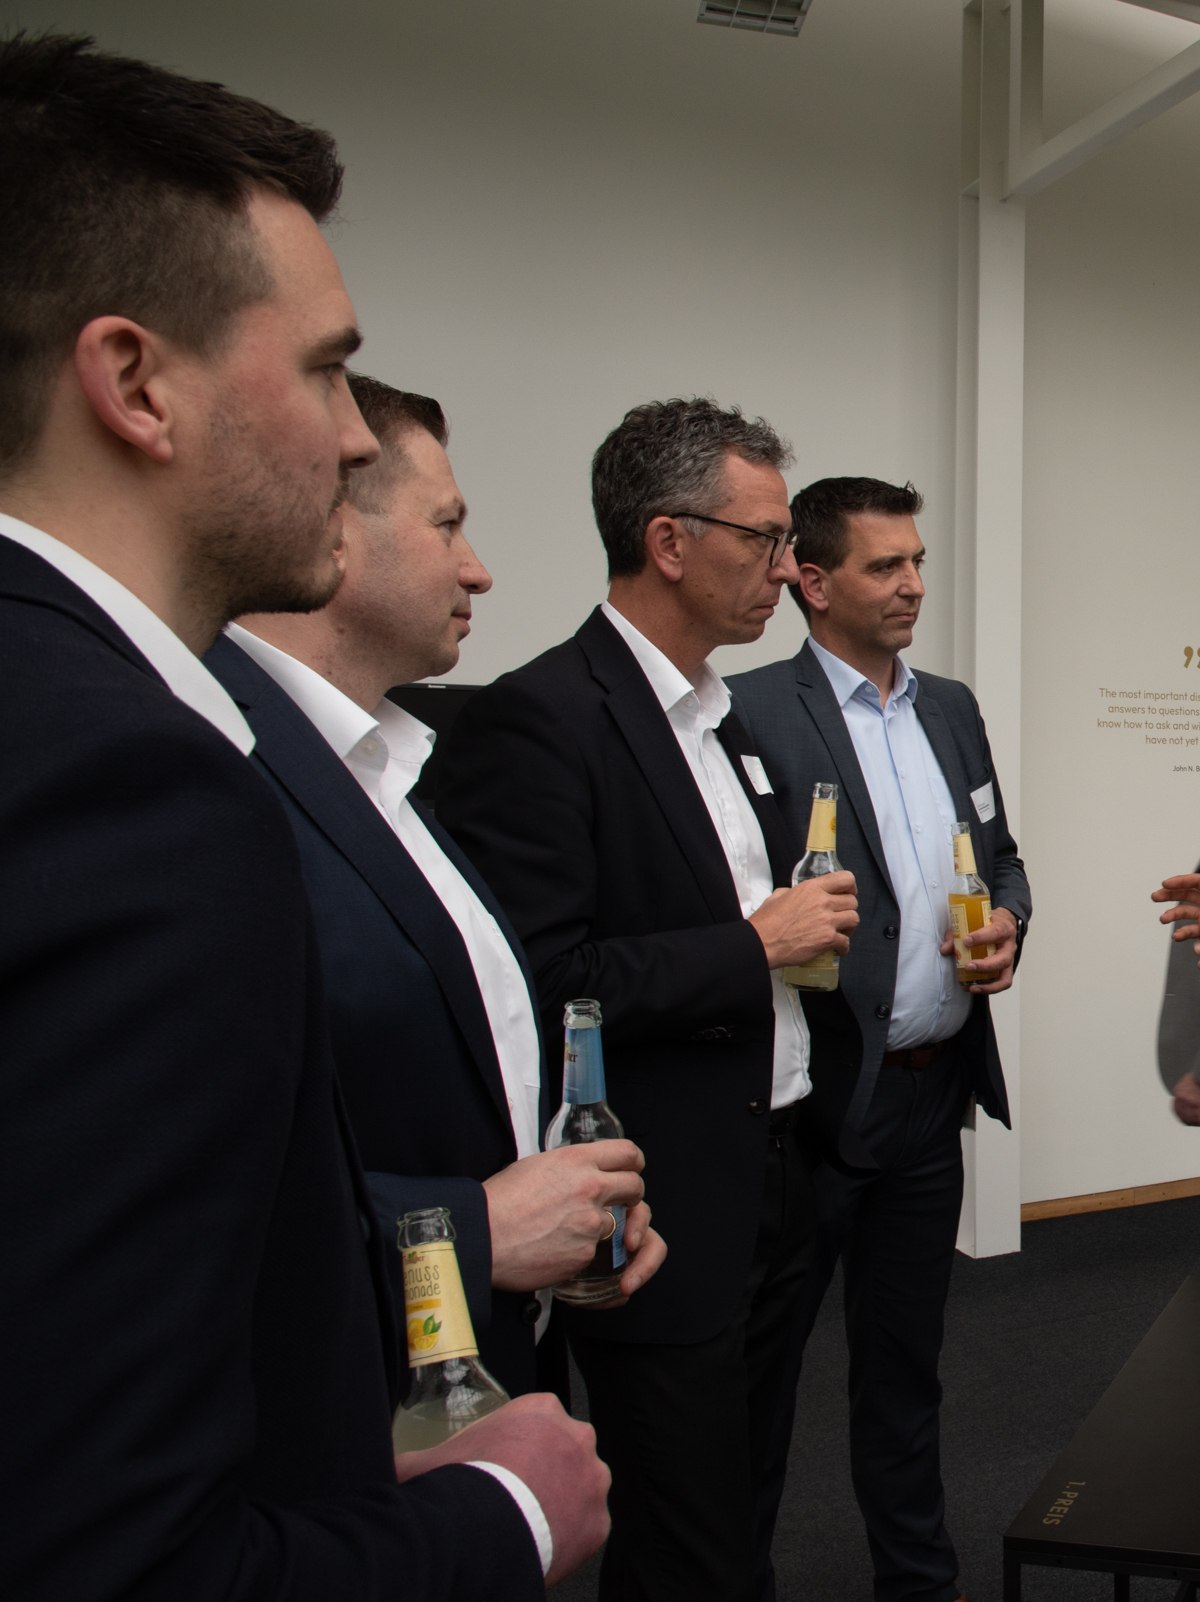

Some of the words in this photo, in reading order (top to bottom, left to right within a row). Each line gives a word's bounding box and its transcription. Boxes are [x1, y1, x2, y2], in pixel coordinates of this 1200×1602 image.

[1099, 687, 1117, 698] The
[1118, 689, 1142, 699] most
[1143, 690, 1188, 702] important
[1108, 704, 1146, 715] answers
[1147, 705, 1157, 715] to
[1158, 706, 1200, 717] questions
[1097, 718, 1122, 728] know
[1123, 719, 1143, 729] how
[1144, 720, 1154, 730] to
[1155, 720, 1171, 730] ask
[1172, 721, 1190, 731] and
[1145, 735, 1168, 745] have
[1168, 736, 1184, 745] not
[1185, 736, 1199, 747] yet
[1042, 1490, 1079, 1526] PREIS
